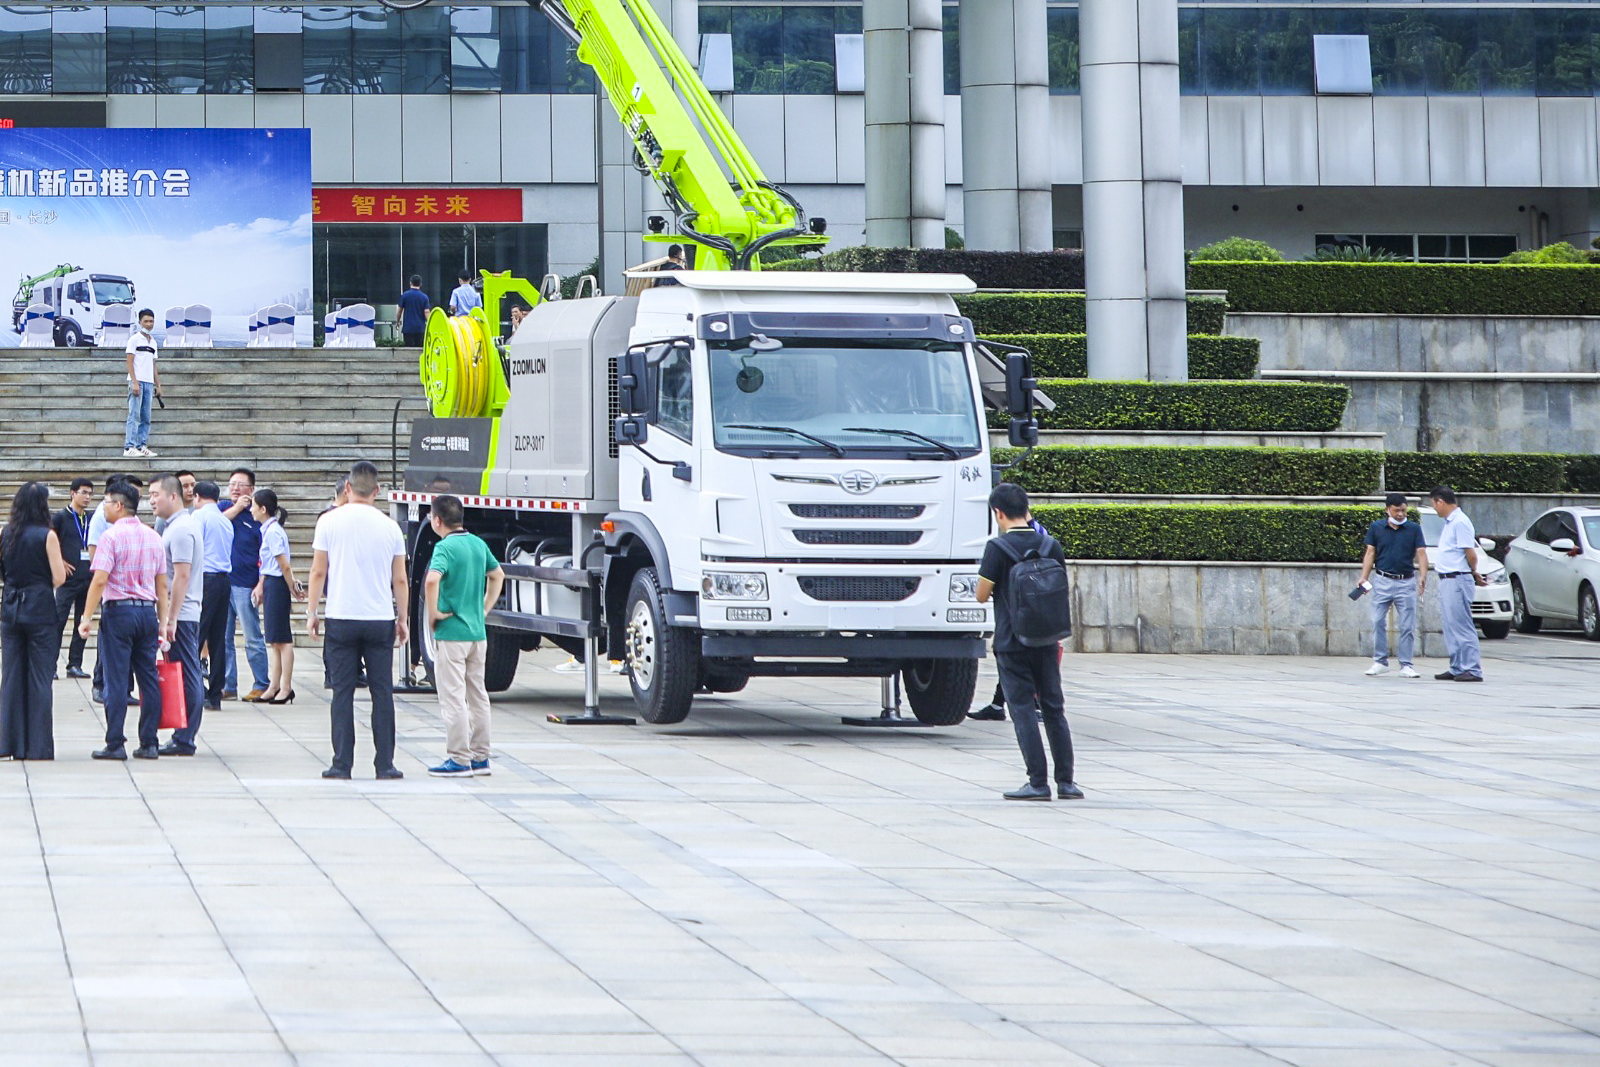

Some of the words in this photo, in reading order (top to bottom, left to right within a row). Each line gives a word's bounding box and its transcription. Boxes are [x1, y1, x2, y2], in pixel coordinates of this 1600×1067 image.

[351, 194, 471, 216] 智向未来
[512, 358, 547, 376] ZOOMLION
[514, 435, 546, 452] ZLCP-3017
